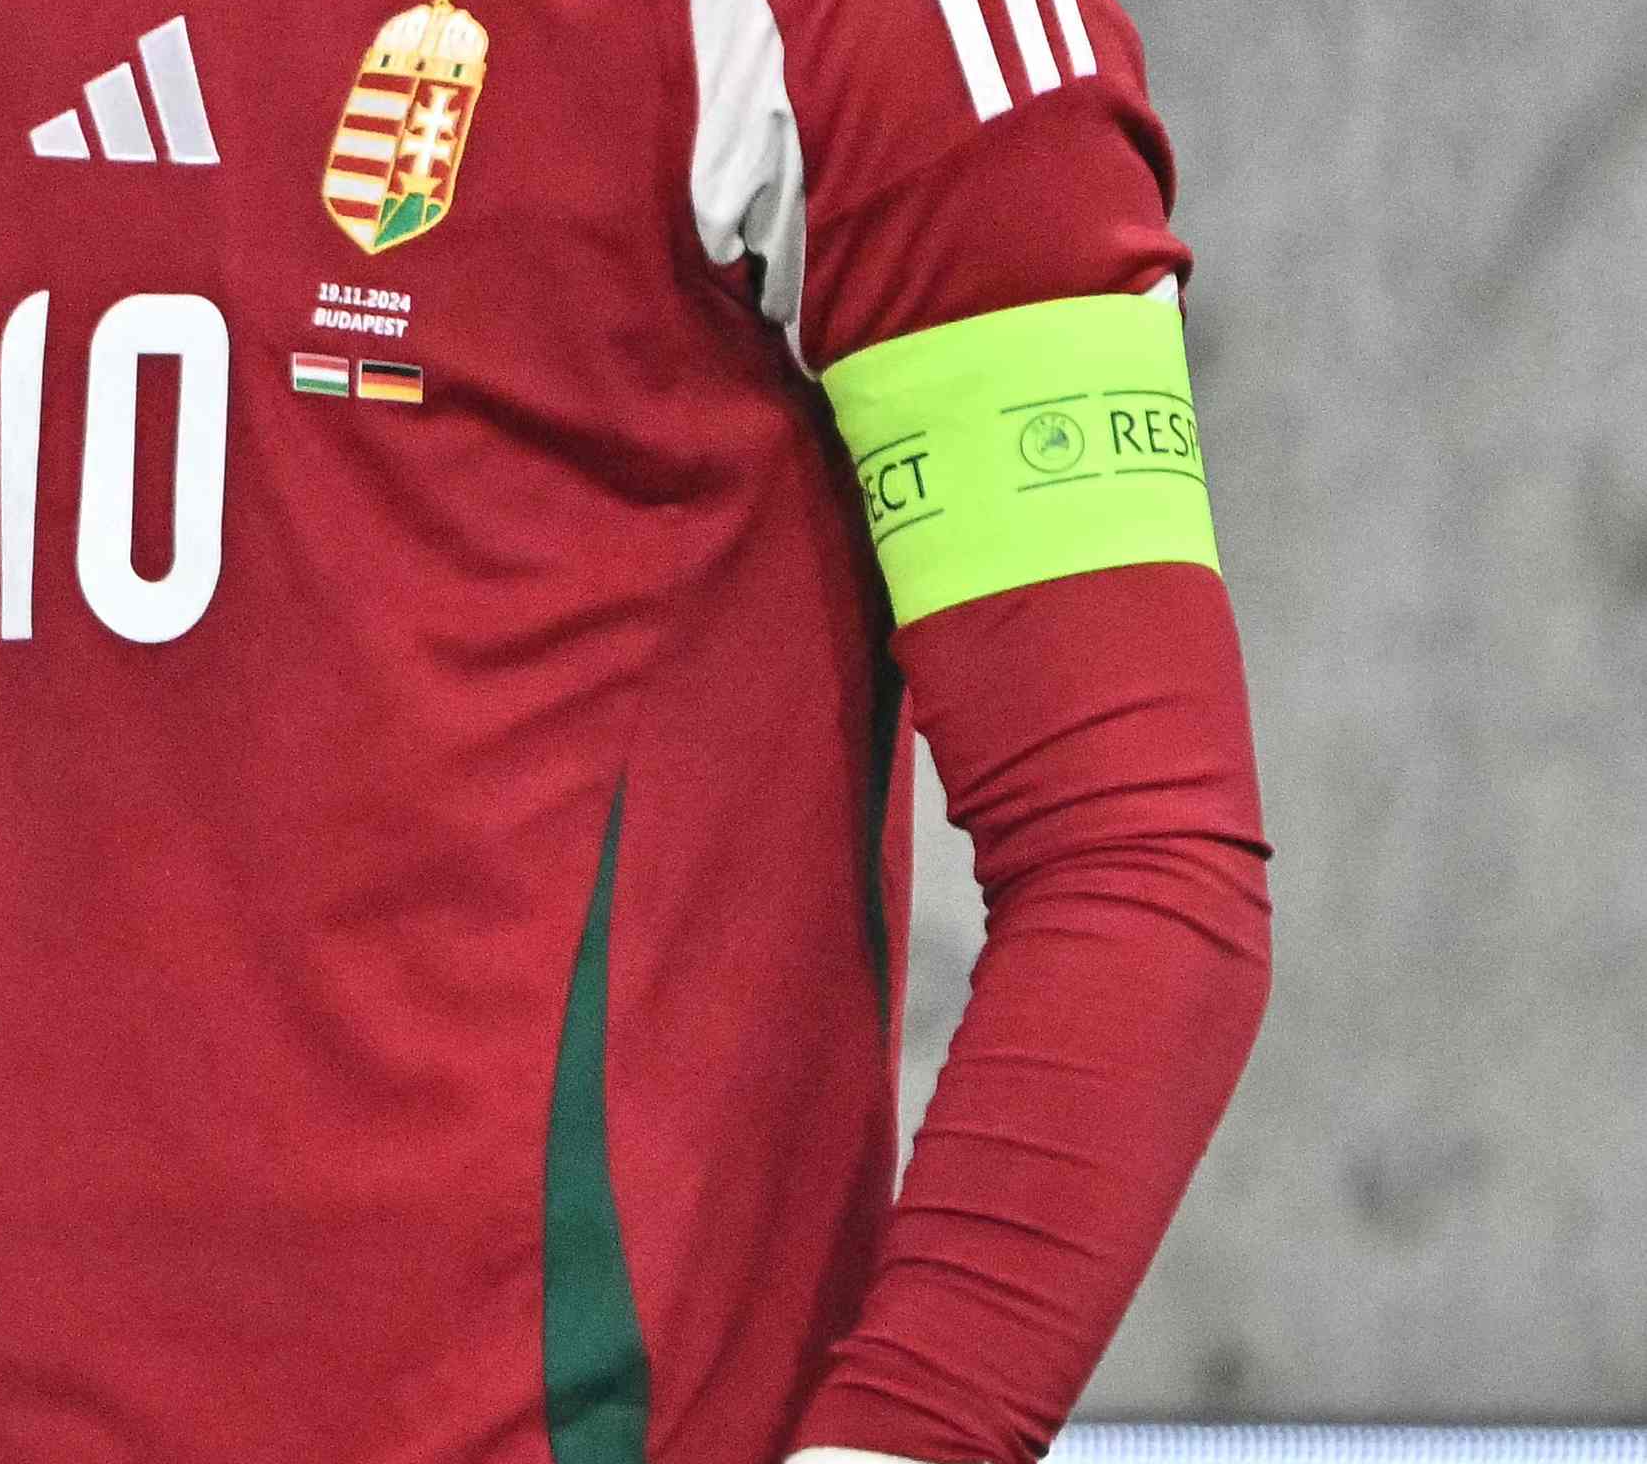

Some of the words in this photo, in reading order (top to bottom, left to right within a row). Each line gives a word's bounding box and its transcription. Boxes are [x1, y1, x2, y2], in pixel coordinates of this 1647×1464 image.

[318, 281, 411, 313] 19.11.2024
[312, 306, 409, 339] BUDAPEST
[863, 452, 929, 524] ECT
